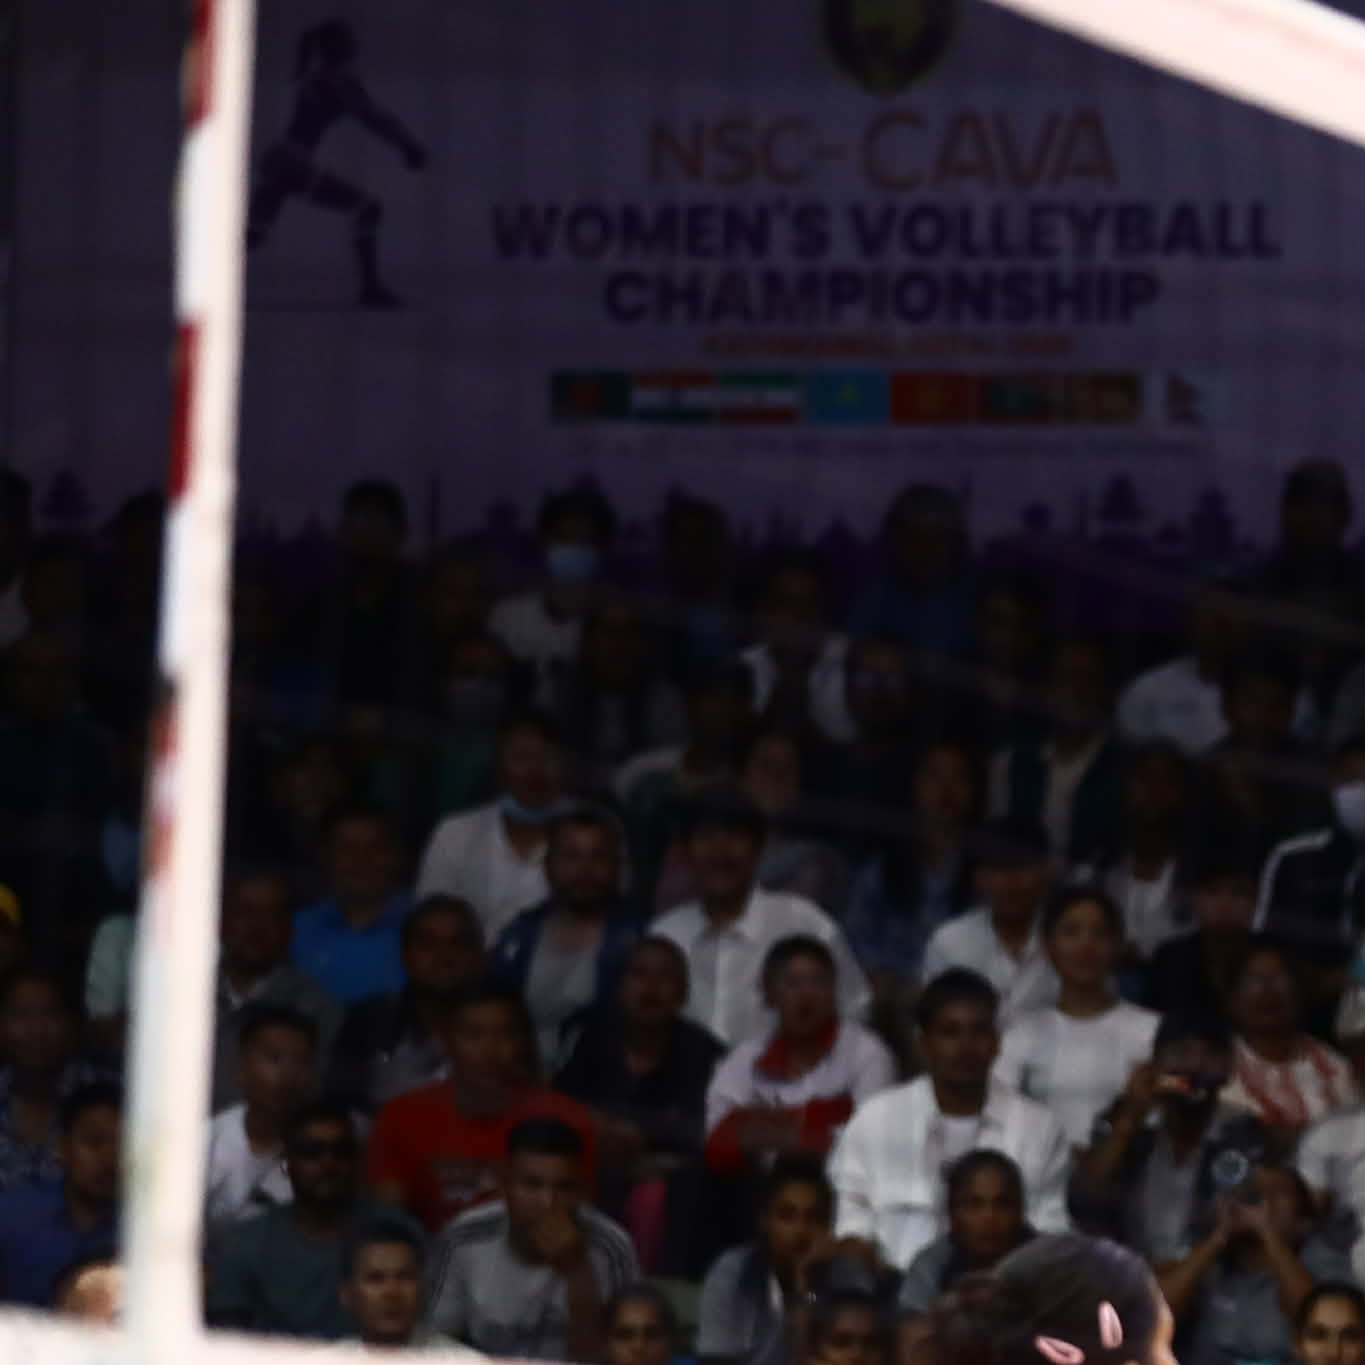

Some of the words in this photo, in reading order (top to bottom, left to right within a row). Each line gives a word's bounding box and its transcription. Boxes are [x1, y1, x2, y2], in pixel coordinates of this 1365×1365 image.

[490, 198, 831, 261] WOMEN'S
[847, 199, 1282, 260] VOLLEYBALL
[603, 267, 1162, 325] CHAMPIONSHIP
